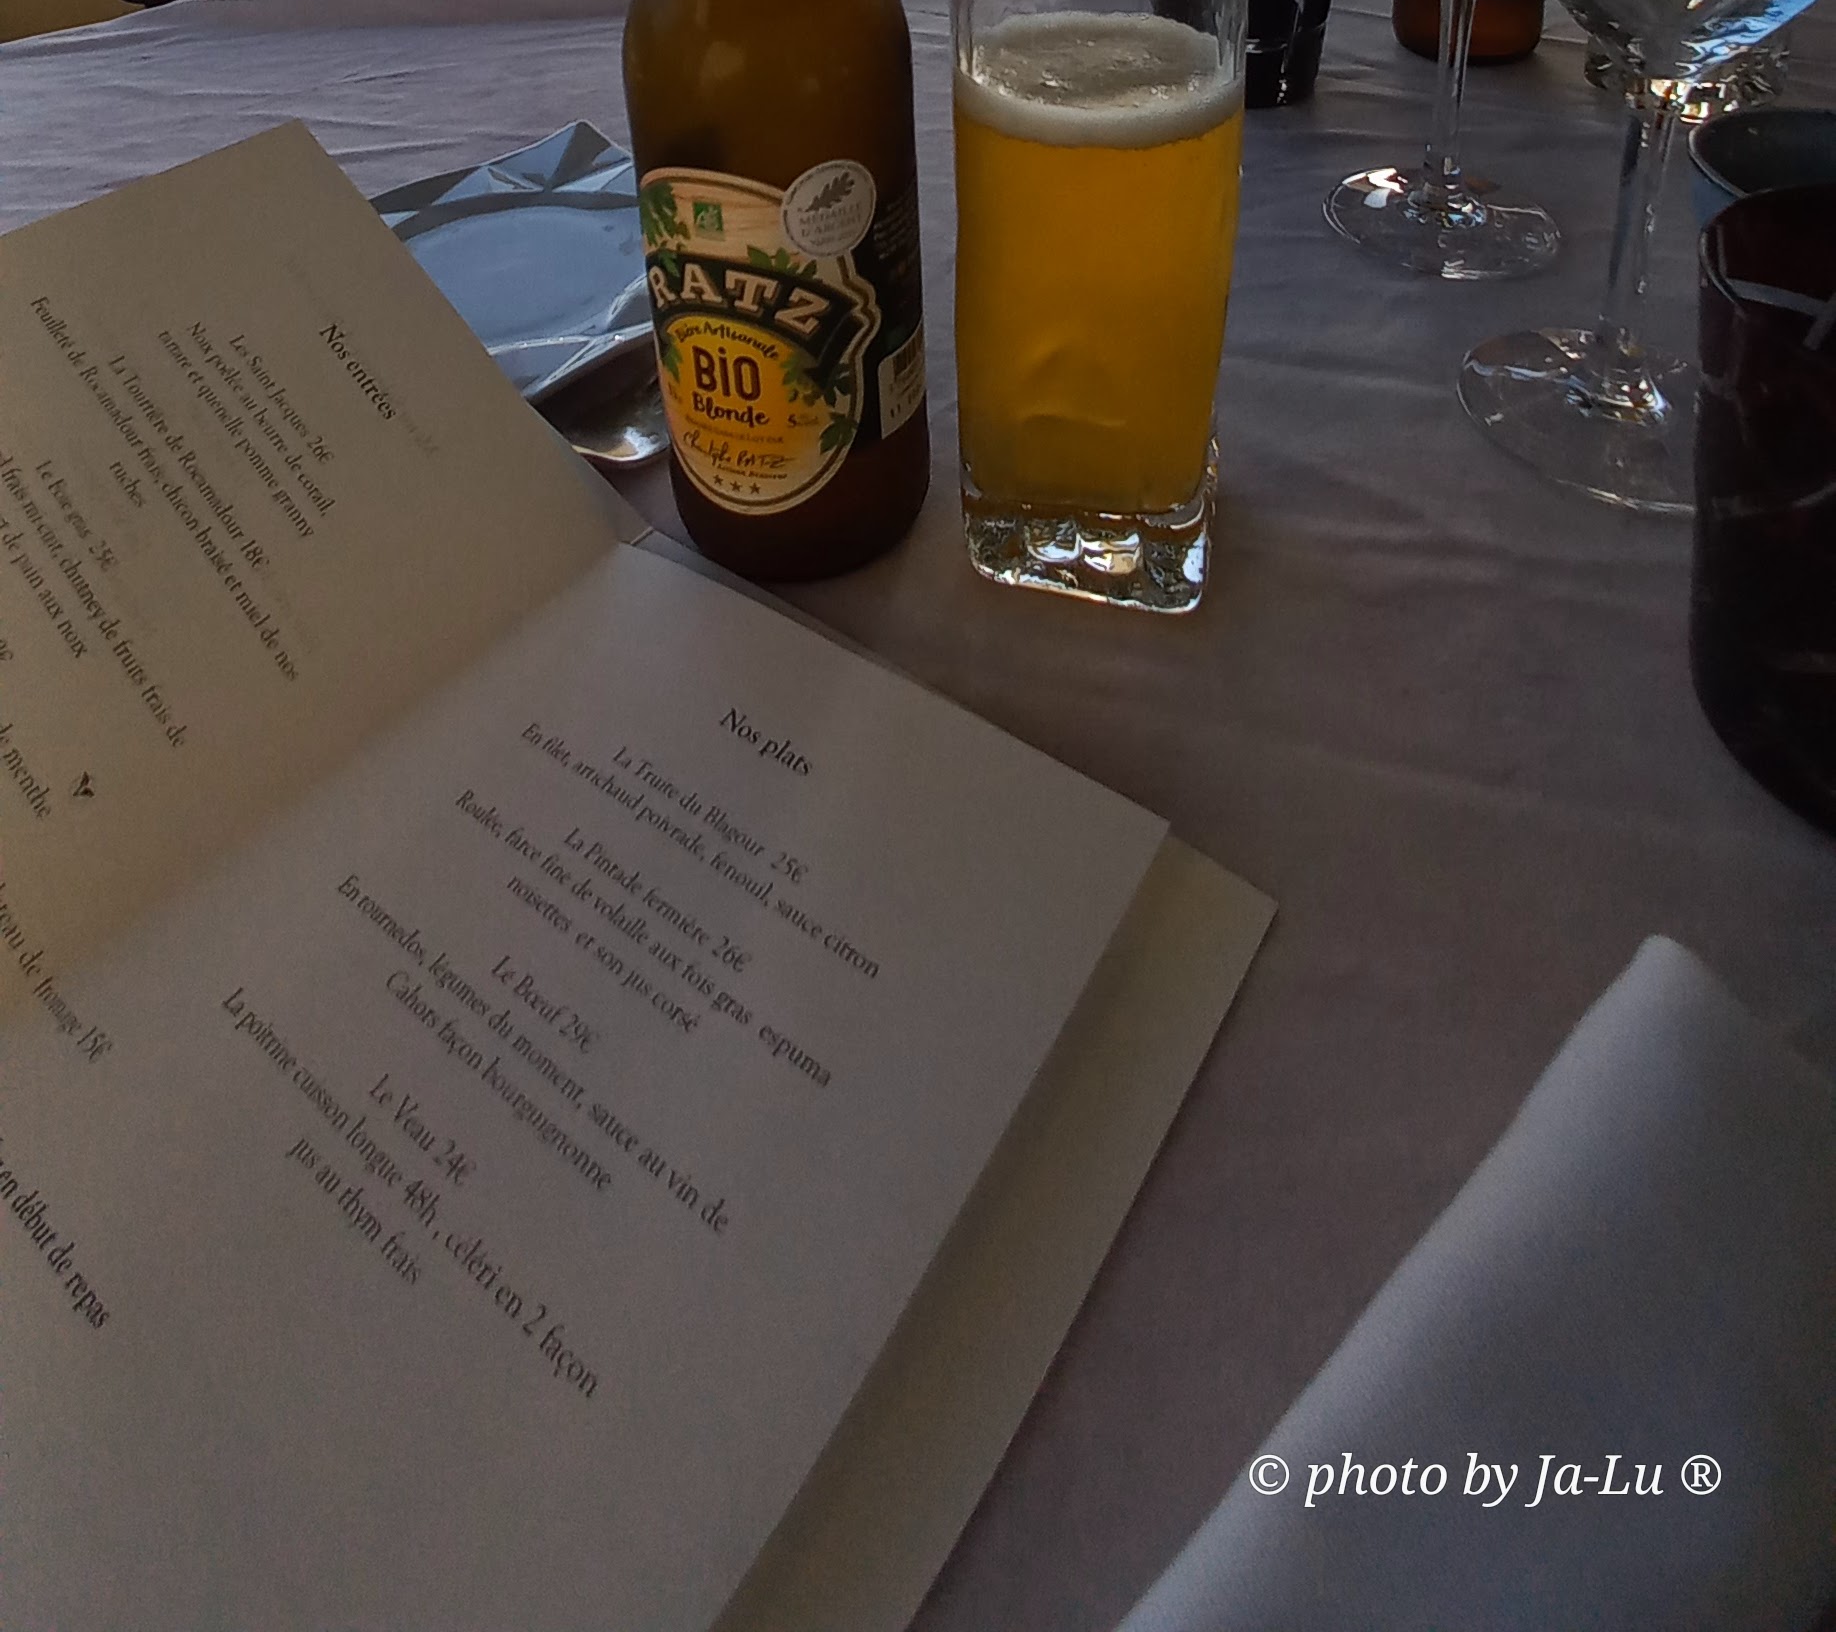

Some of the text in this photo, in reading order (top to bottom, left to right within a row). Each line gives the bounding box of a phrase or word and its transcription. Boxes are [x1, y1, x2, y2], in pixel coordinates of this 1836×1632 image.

[319, 323, 396, 420] Nos entrées
[649, 263, 830, 335] RATZ
[36, 459, 53, 480] Le
[108, 354, 126, 376] La
[165, 434, 185, 452] de
[178, 449, 245, 541] Rocamadour
[240, 539, 270, 571] 18€
[157, 329, 315, 538] tartare et quenelle pomme granny
[187, 321, 213, 355] Noix
[242, 394, 259, 412] au
[253, 407, 288, 453] beurre
[284, 453, 303, 472] de
[298, 473, 336, 518] corail,
[229, 334, 335, 465] Les Saint Jacques 26€
[692, 391, 770, 428] Blonde
[30, 296, 76, 350] Feuilleté
[67, 349, 87, 368] de
[79, 365, 144, 449] Rocamadour
[161, 485, 200, 532] chicon
[195, 525, 234, 575] braisé
[223, 572, 244, 592] et
[235, 589, 272, 628] miel
[260, 627, 280, 651] de
[274, 650, 299, 682] nos
[109, 461, 147, 508] ruches
[1, 532, 89, 659] de pain aux noix
[1, 466, 27, 502] frais
[59, 556, 108, 622] chutney
[99, 619, 121, 641] de
[112, 639, 148, 686] fruits
[141, 683, 173, 725] frais
[165, 724, 188, 748] de
[3, 747, 51, 818] menthe
[612, 745, 809, 885] La Truite du Blagour 25€
[719, 707, 813, 777] Nos plats
[520, 721, 880, 979] En filet, artichaud poivrade, fenouil, sauce citron
[563, 826, 752, 974] La Pintade fermière 26€
[19, 950, 44, 977] de
[491, 955, 517, 985] Le
[558, 1013, 599, 1054] 29€
[504, 825, 542, 863] farce
[540, 853, 573, 886] fine
[570, 877, 594, 902] de
[592, 902, 649, 945] volaille
[648, 940, 683, 972] aux
[680, 961, 716, 996] fois
[710, 991, 752, 1025] gras
[758, 1024, 832, 1088] espuma
[507, 875, 702, 1033] noisettes et son jus corsé
[337, 872, 729, 1234] En tournedos, légumes du moment, sauce au vin de
[385, 970, 613, 1190] Cahors façon bourguignonne
[222, 987, 245, 1018] La
[235, 1011, 297, 1070] poitrine
[292, 1066, 349, 1130] cuisson
[345, 1116, 402, 1187] longue
[494, 1285, 523, 1318] en
[521, 1303, 547, 1336] 2
[539, 1323, 599, 1398] façon
[369, 1073, 477, 1187] Le Veau 24€
[0, 1170, 110, 1329] en début de repas
[285, 1137, 421, 1285] jus au thym frais
